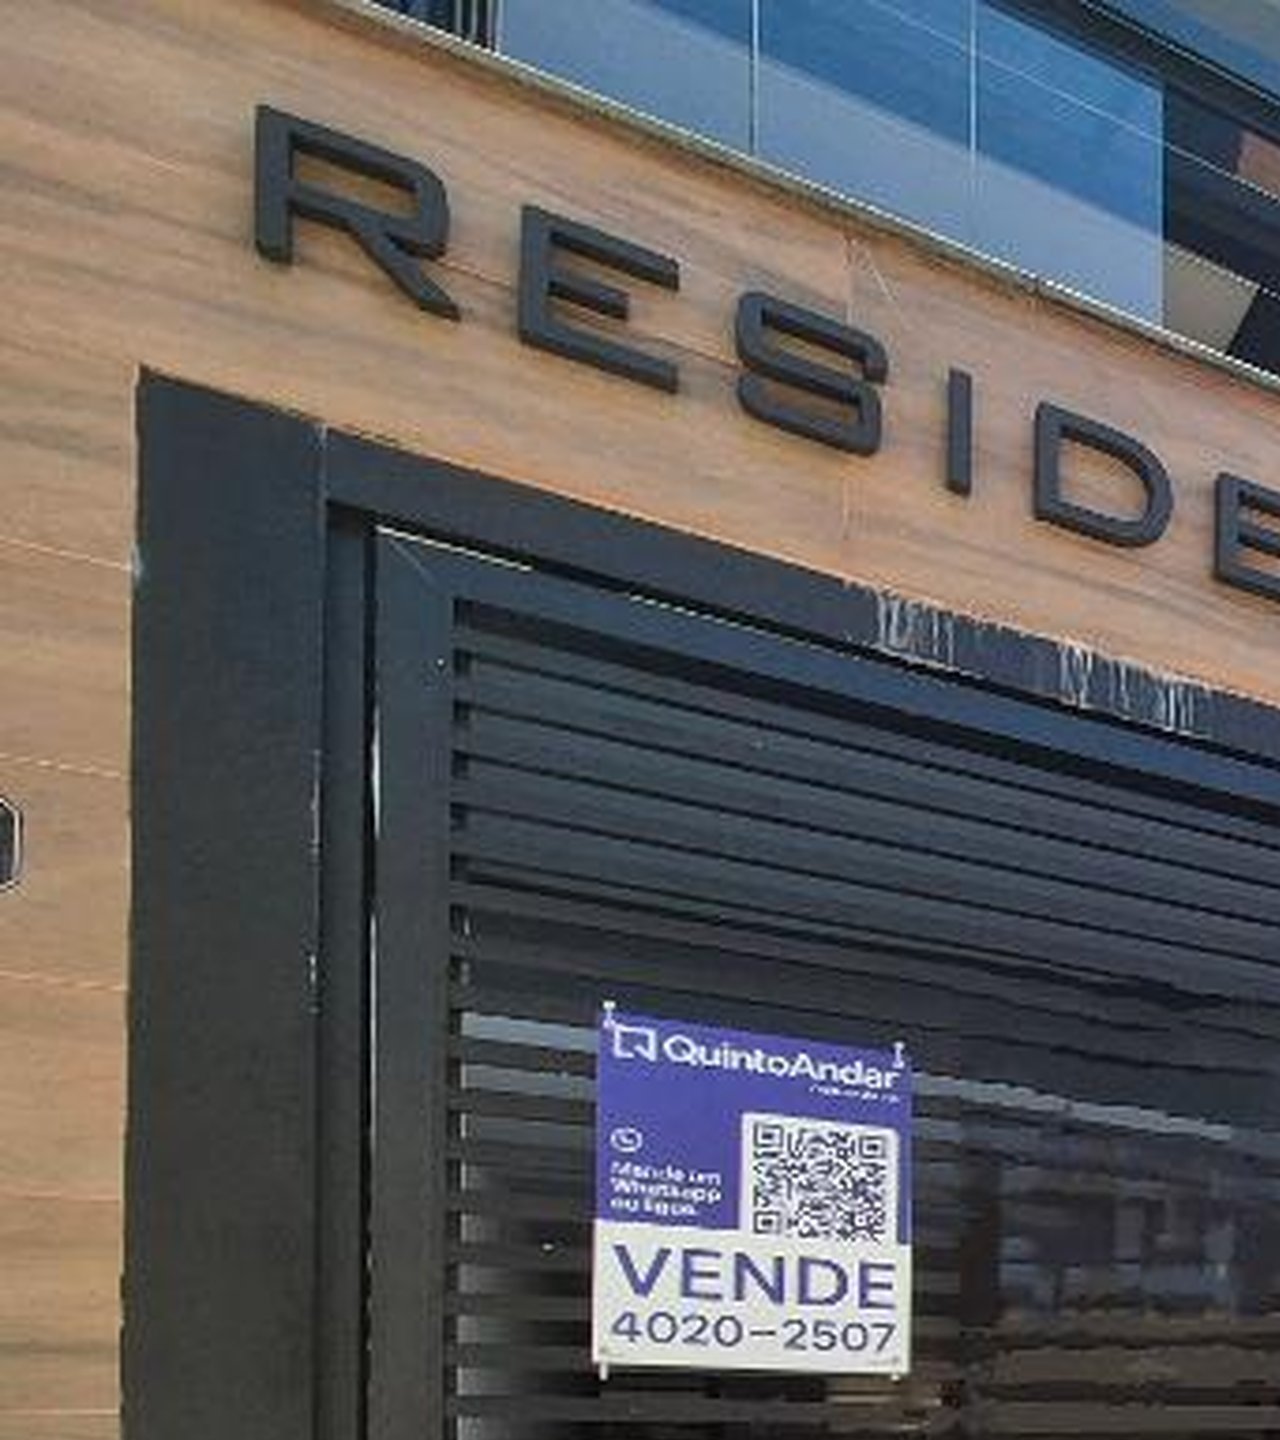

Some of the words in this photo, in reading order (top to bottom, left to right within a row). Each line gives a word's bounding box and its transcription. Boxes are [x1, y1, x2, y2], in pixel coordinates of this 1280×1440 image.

[663, 1034, 900, 1089] QuintoAndar
[613, 1245, 896, 1309] VENDE
[611, 1310, 896, 1351] 4020-2507
